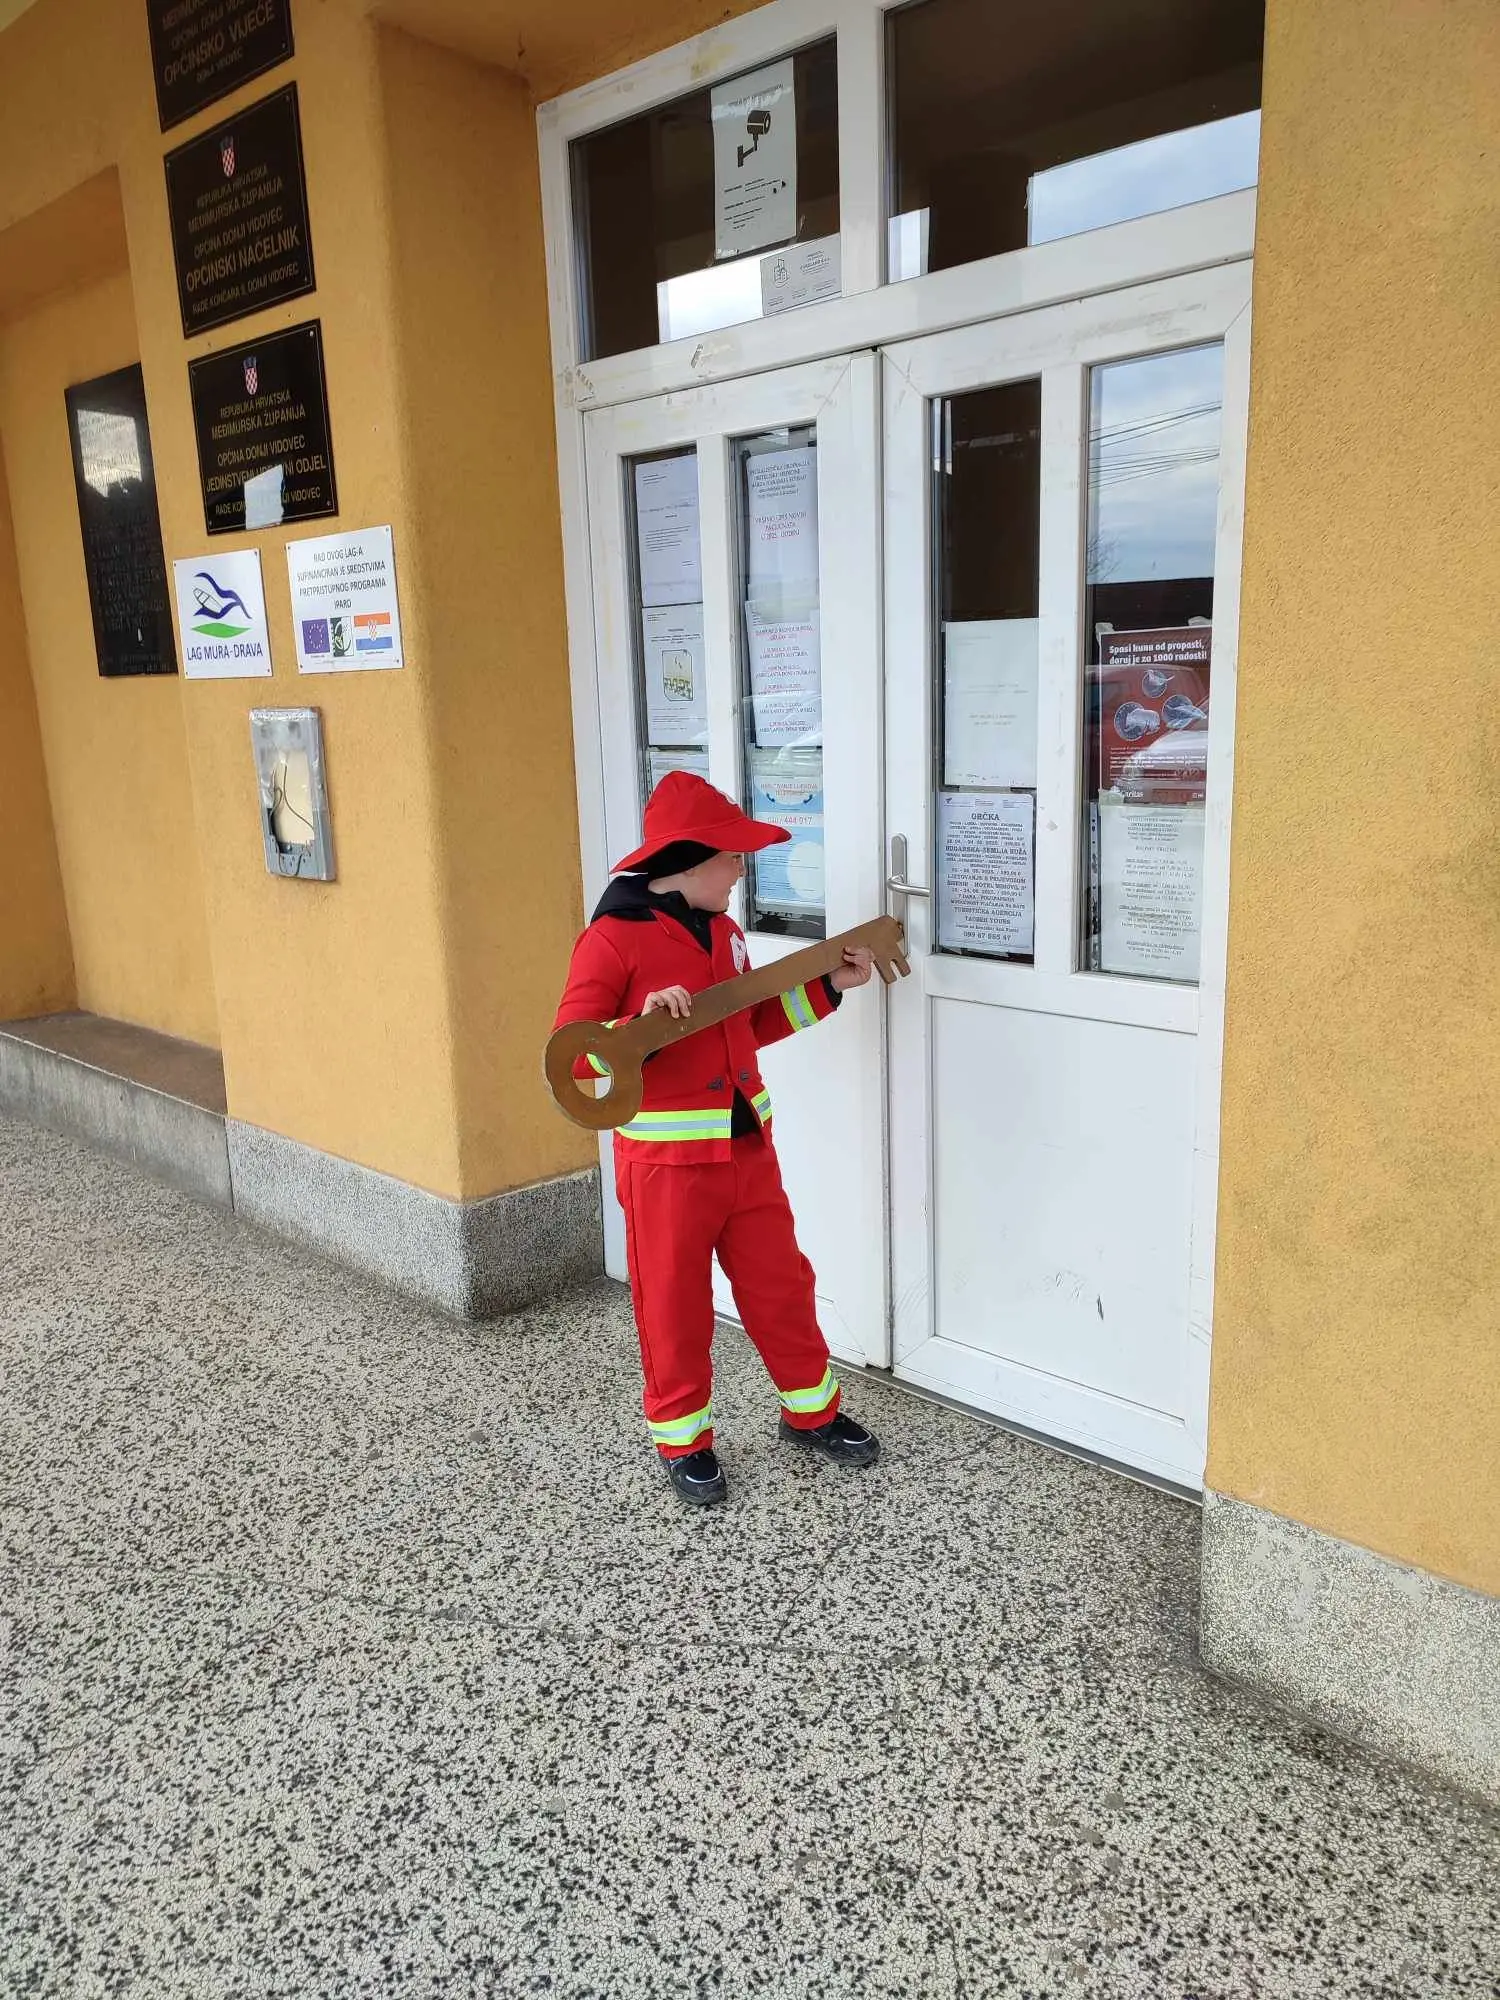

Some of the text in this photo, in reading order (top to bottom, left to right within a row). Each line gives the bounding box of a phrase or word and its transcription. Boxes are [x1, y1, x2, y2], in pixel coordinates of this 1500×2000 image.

[247, 207, 283, 234] VIDOVEC
[269, 261, 299, 284] VIDOVEC
[220, 389, 291, 418] REPUBLIKA HRVATSKA
[264, 403, 306, 426] ŽUPANIJA
[246, 442, 268, 460] DONJI
[269, 433, 305, 455] VIDOVEC
[296, 454, 326, 474] ODJEL
[290, 486, 321, 503] VIDOVEC
[313, 550, 326, 562] RAD
[327, 549, 344, 561] OVOG
[297, 567, 339, 581] SUFINANCIRAN
[346, 560, 386, 576] SREDSTVIMA
[299, 577, 387, 597] PRETPRISTUPNOG PROGRAMA
[186, 642, 263, 661] LAG MURA-DRAVA
[1109, 643, 1131, 654] Spasi
[1155, 642, 1166, 651] od
[1167, 639, 1204, 652] propasti,
[1132, 654, 1140, 665] je
[1153, 653, 1174, 662] 1000
[1174, 650, 1207, 661] radosti!
